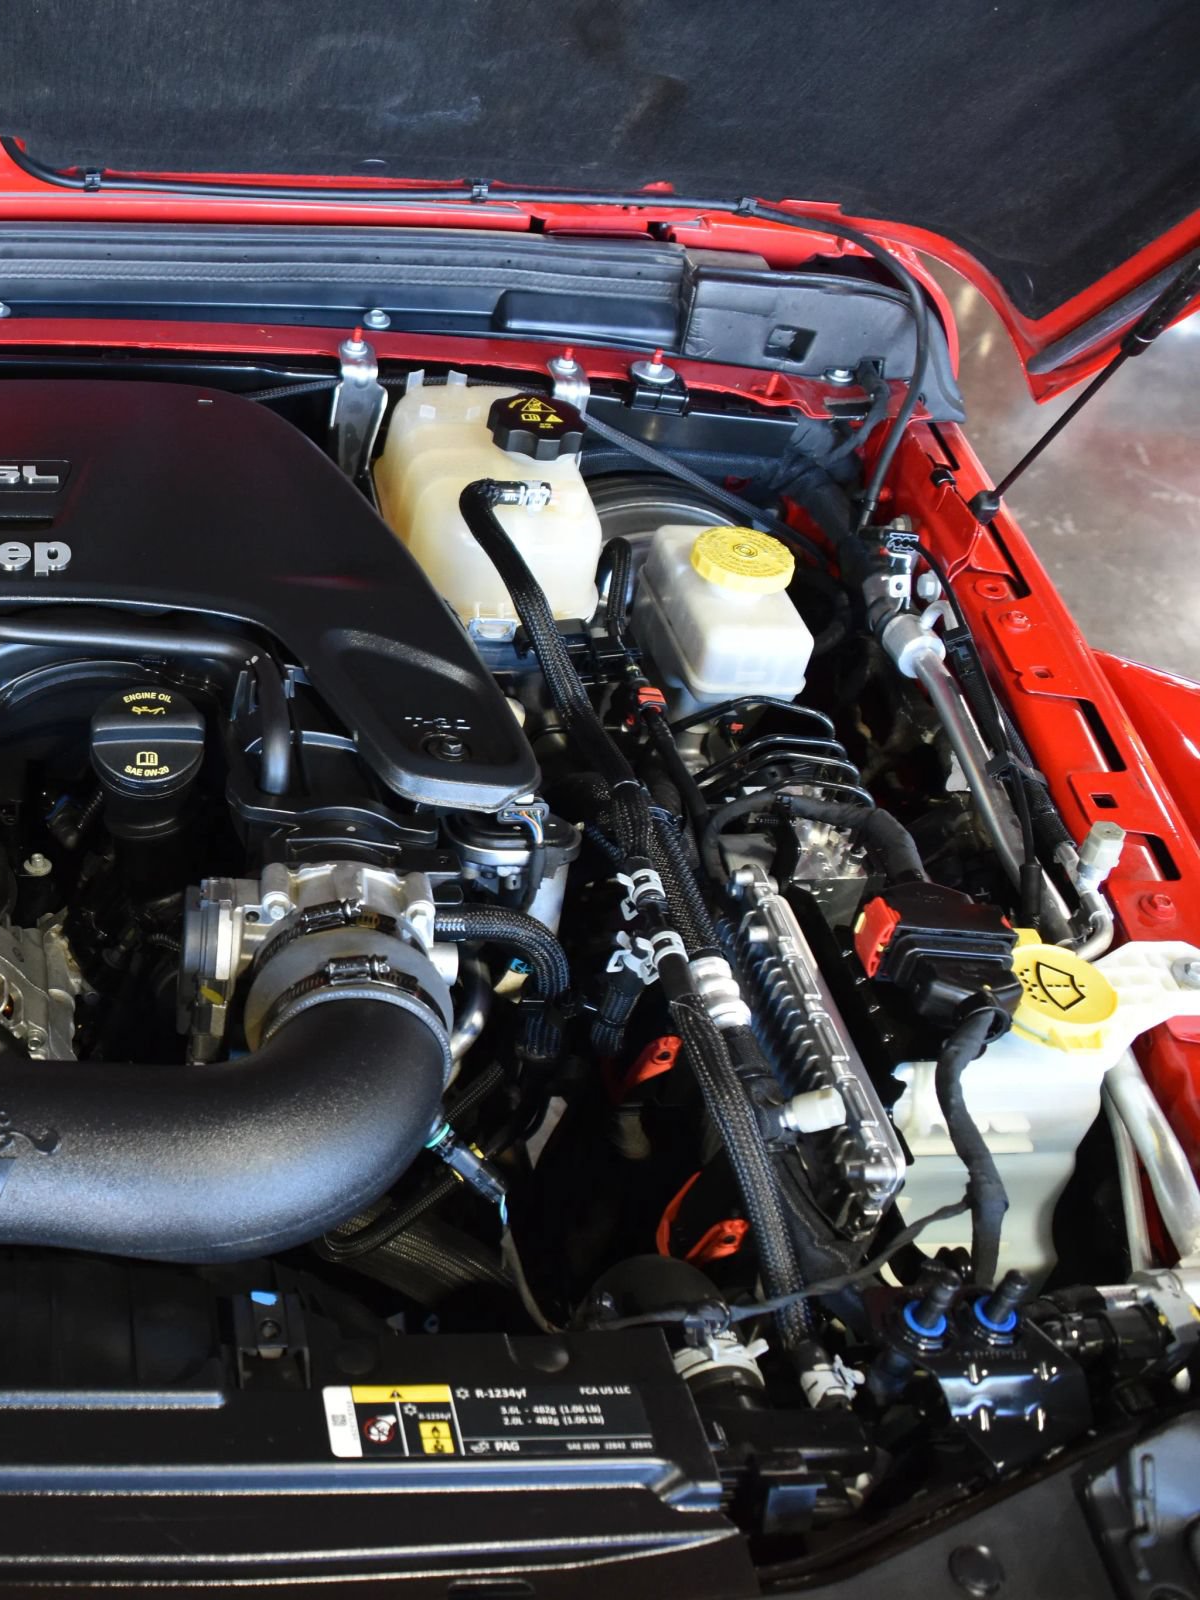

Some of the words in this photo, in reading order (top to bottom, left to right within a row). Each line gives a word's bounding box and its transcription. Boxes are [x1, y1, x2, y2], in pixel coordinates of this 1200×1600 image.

[122, 692, 157, 704] ENGINE
[158, 693, 172, 704] OIL
[124, 765, 143, 776] SAE
[144, 765, 170, 777] 0W-20
[474, 1387, 527, 1400] R-1234yf
[579, 1386, 599, 1396] FCA
[599, 1386, 614, 1395] US
[614, 1385, 632, 1395] LLC
[500, 1405, 521, 1415] 3.6L
[503, 1416, 525, 1426] 2.0L
[494, 1441, 520, 1452] PAG
